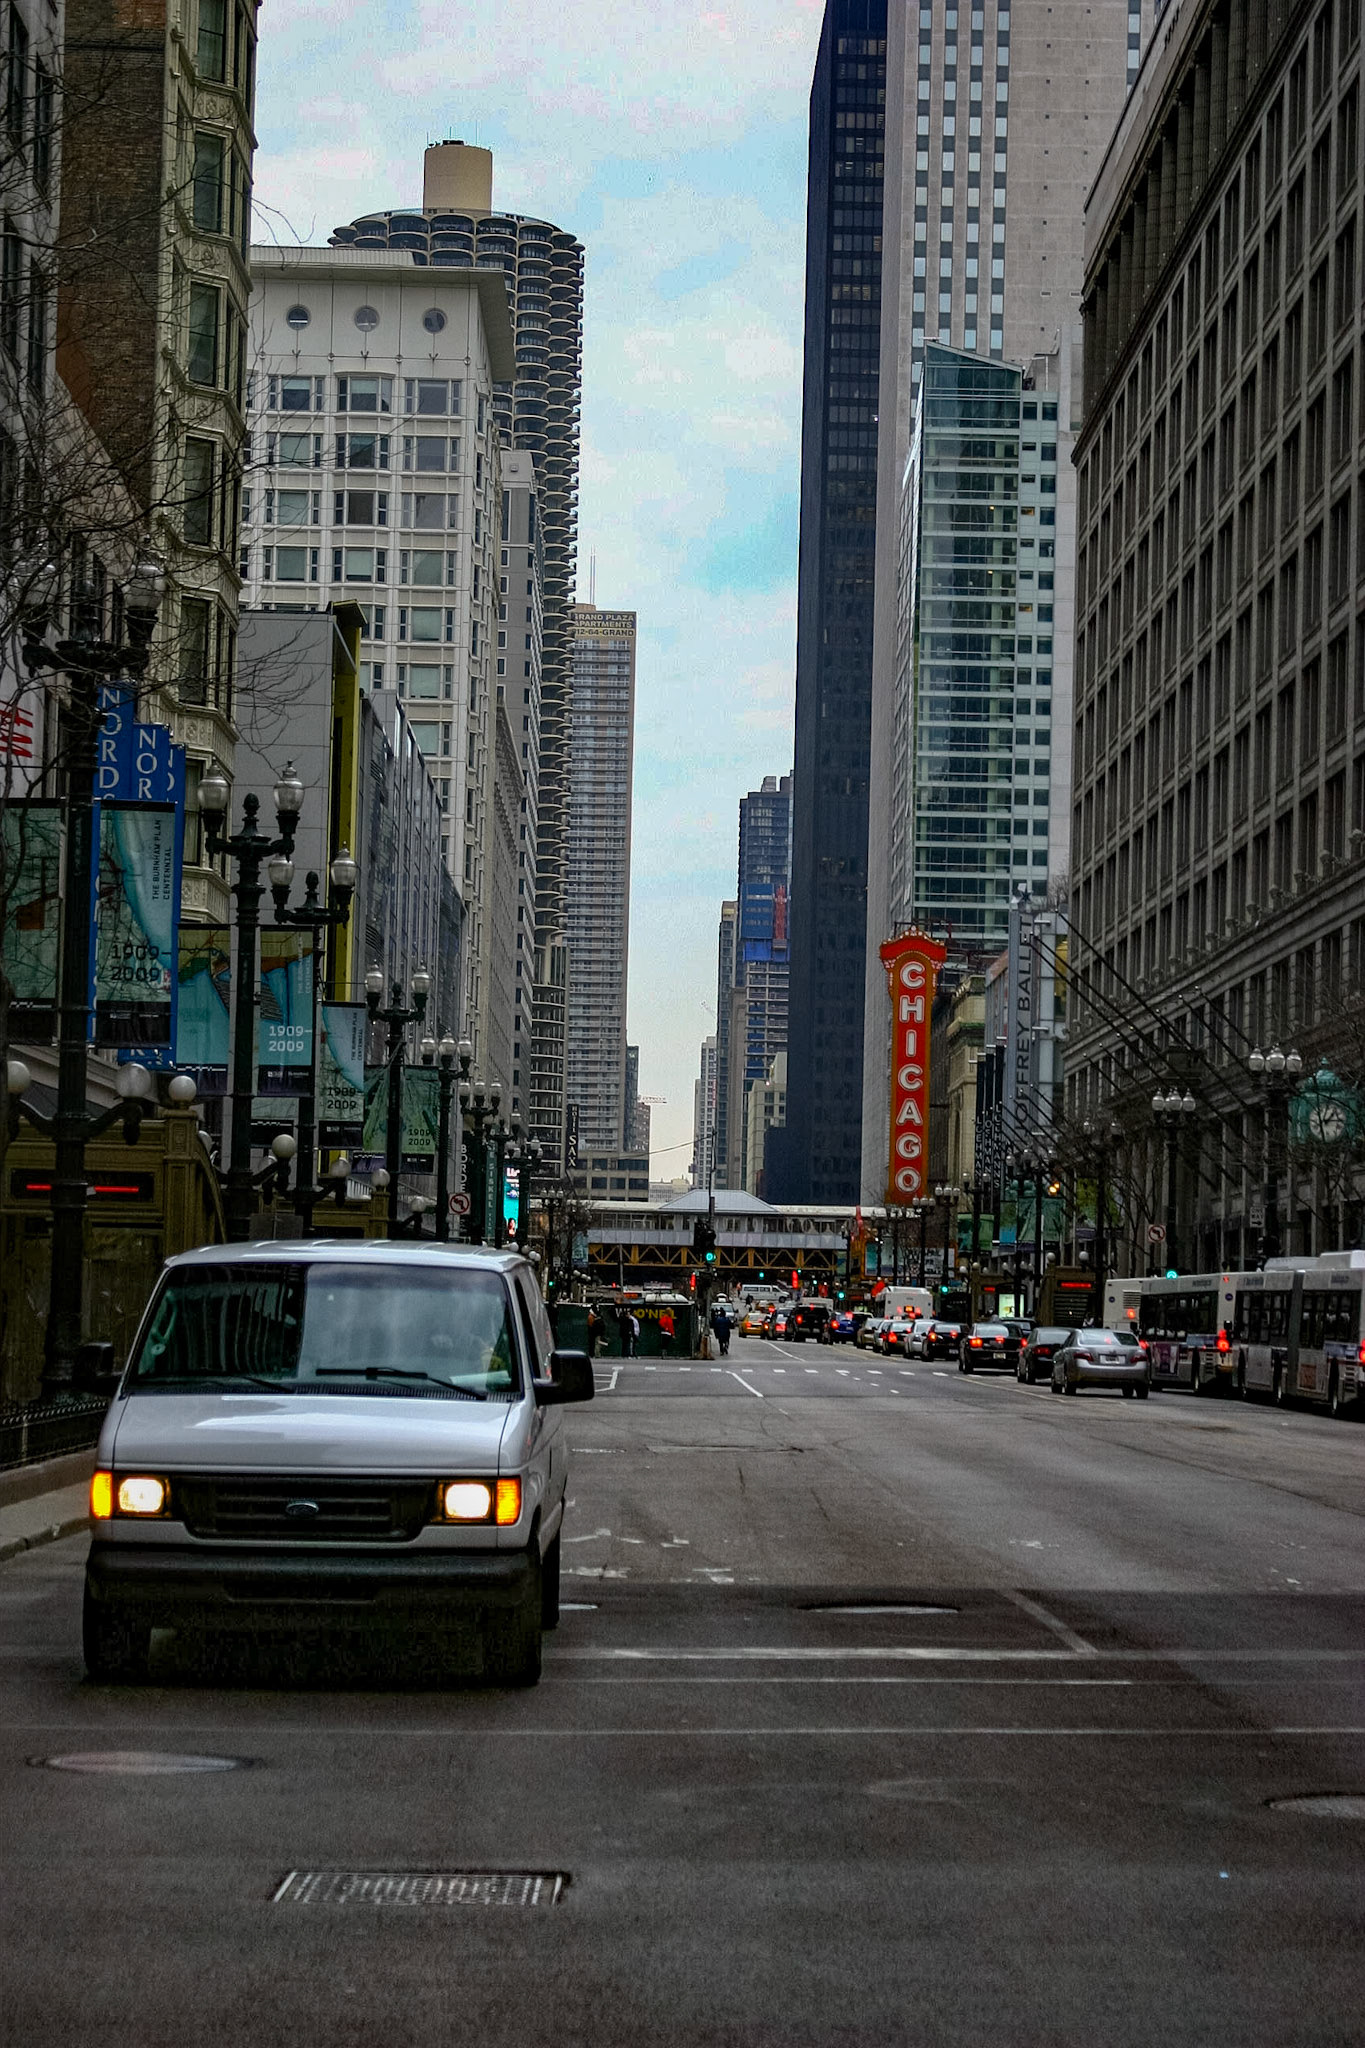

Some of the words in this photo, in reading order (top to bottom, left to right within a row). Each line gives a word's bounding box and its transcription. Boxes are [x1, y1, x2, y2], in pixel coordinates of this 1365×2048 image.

[574, 621, 632, 629] APARTMENTS
[98, 687, 122, 800] NORD
[136, 728, 158, 800] NOR
[152, 885, 160, 901] THE
[111, 966, 160, 982] 2009
[1018, 915, 1032, 1012] BALLET
[268, 1040, 304, 1052] 2009
[894, 960, 926, 1193] CHICAGO
[1015, 1020, 1031, 1137] JOFFREY
[327, 1100, 357, 1110] 2009
[408, 1138, 431, 1147] 2009
[568, 1134, 577, 1169] SAX
[460, 1143, 468, 1193] BORDE
[633, 1307, 677, 1320] O'NEL
